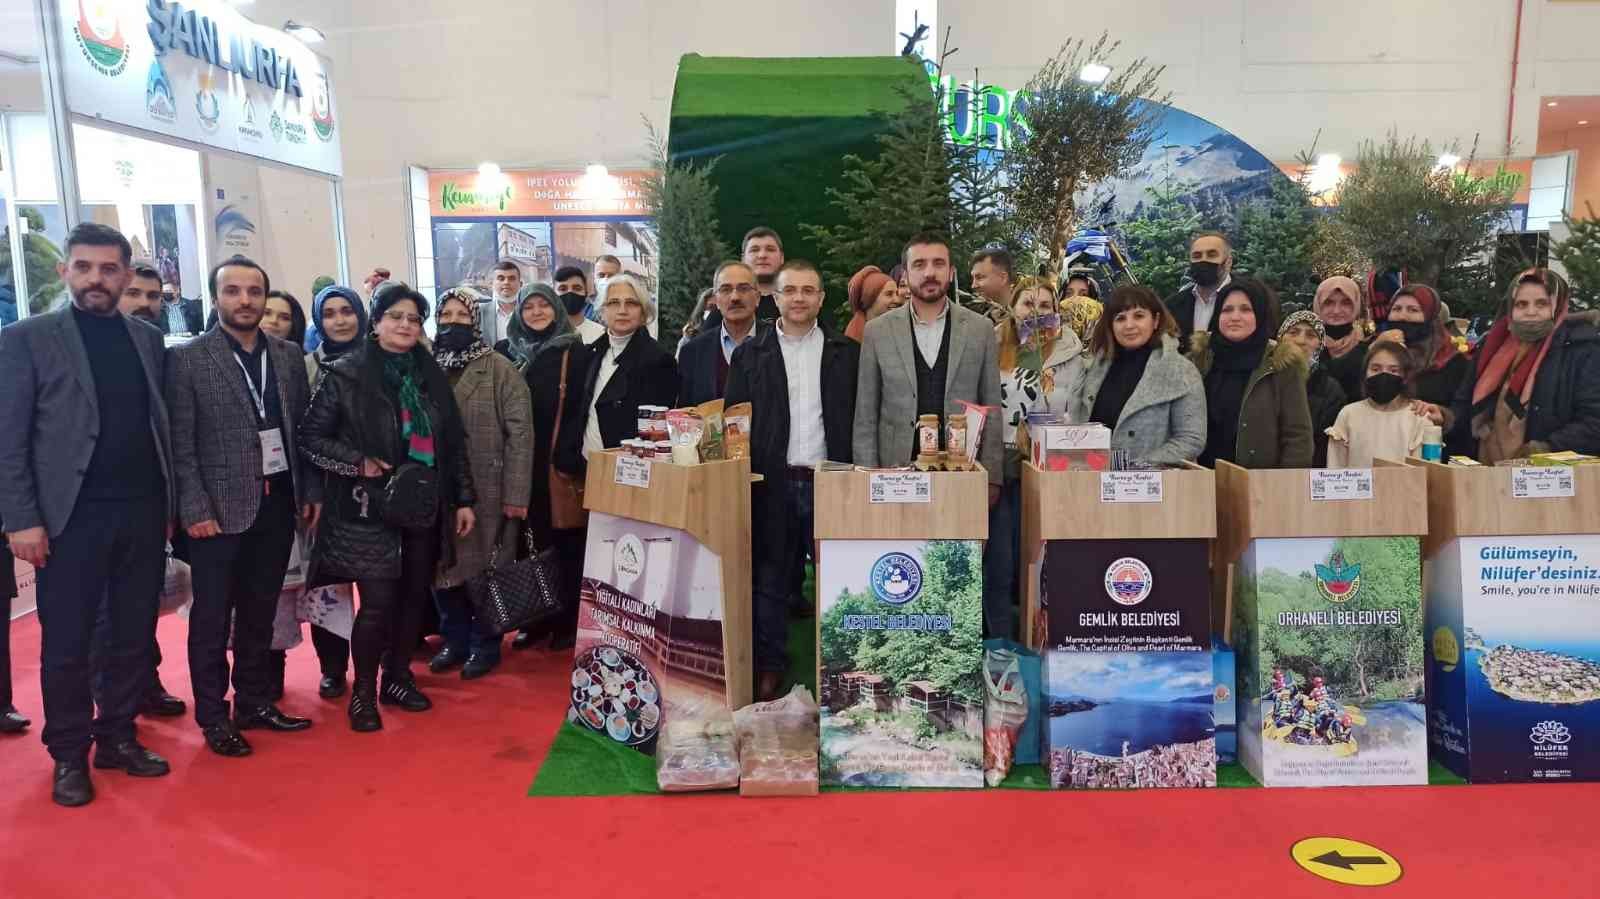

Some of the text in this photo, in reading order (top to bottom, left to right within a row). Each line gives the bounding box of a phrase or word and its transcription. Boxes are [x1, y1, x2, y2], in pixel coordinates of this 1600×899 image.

[1480, 545, 1577, 562] Gülümseyin,
[1480, 566, 1600, 583] Nilüfer'desiniz.
[1480, 584, 1600, 597] Smile, you're in Nilüfe
[1079, 610, 1180, 627] GEMLİK BELEDİYESİ
[1278, 608, 1401, 626] ORHANELİ BELEDİYESİ
